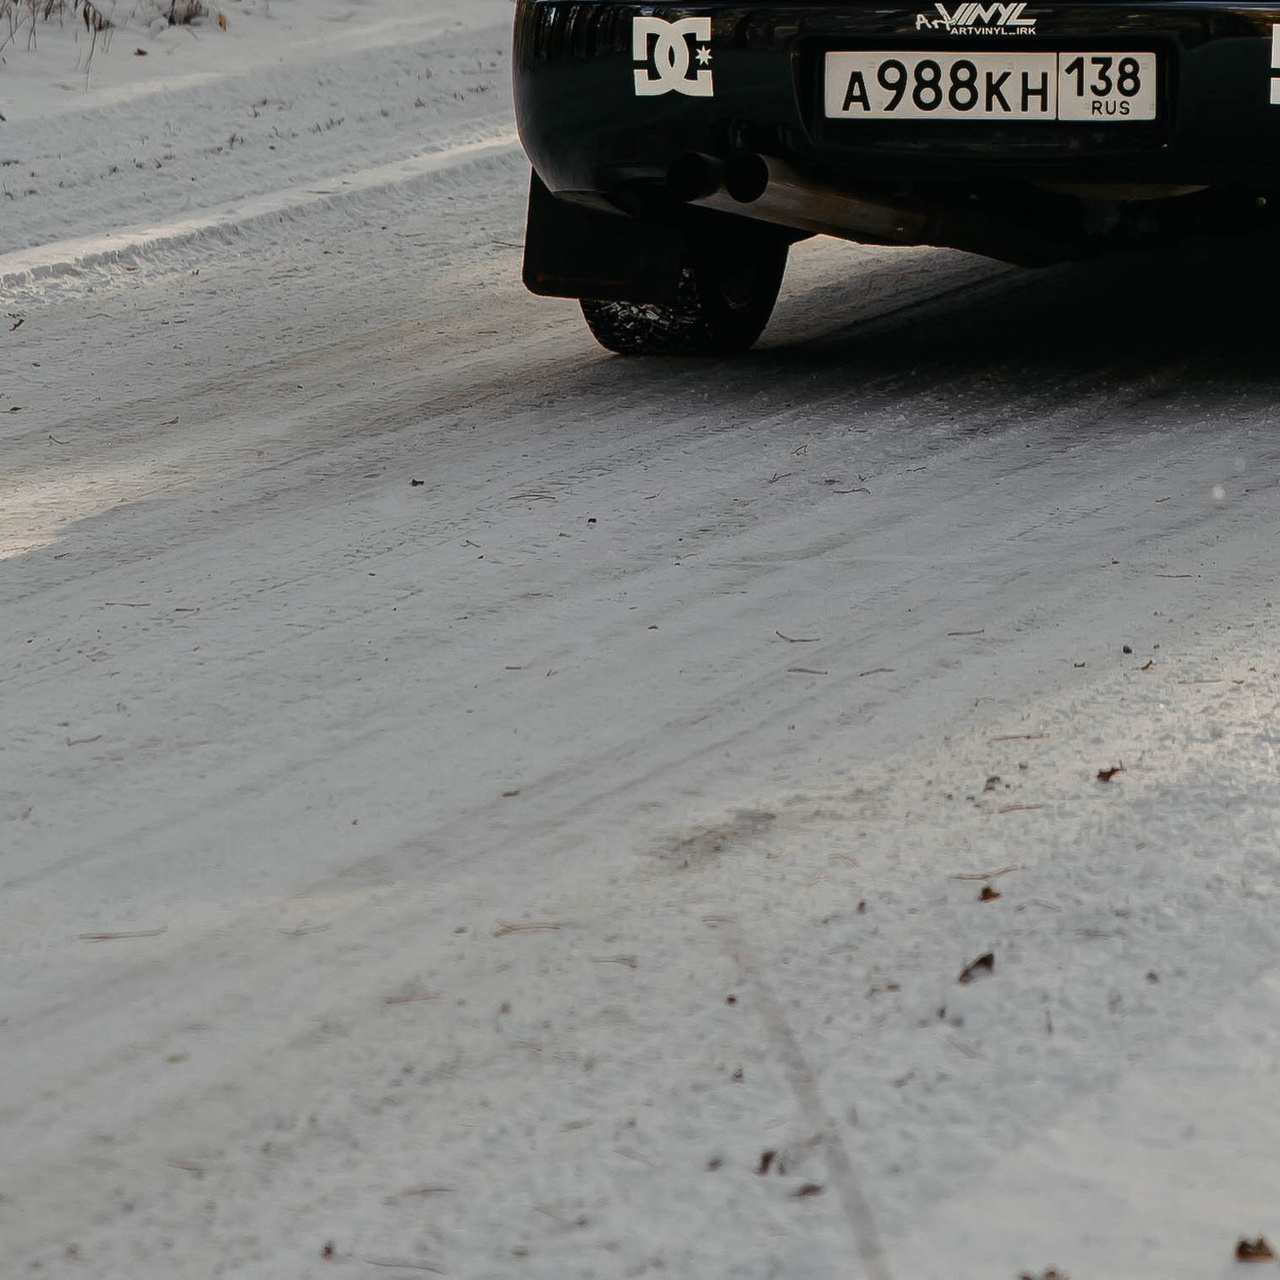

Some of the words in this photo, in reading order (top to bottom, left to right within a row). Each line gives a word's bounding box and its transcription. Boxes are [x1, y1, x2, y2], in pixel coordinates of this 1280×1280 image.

[950, 27, 1036, 35] ARTVINYL_IRK
[1065, 57, 1140, 97] 138
[1091, 101, 1131, 115] RUS
